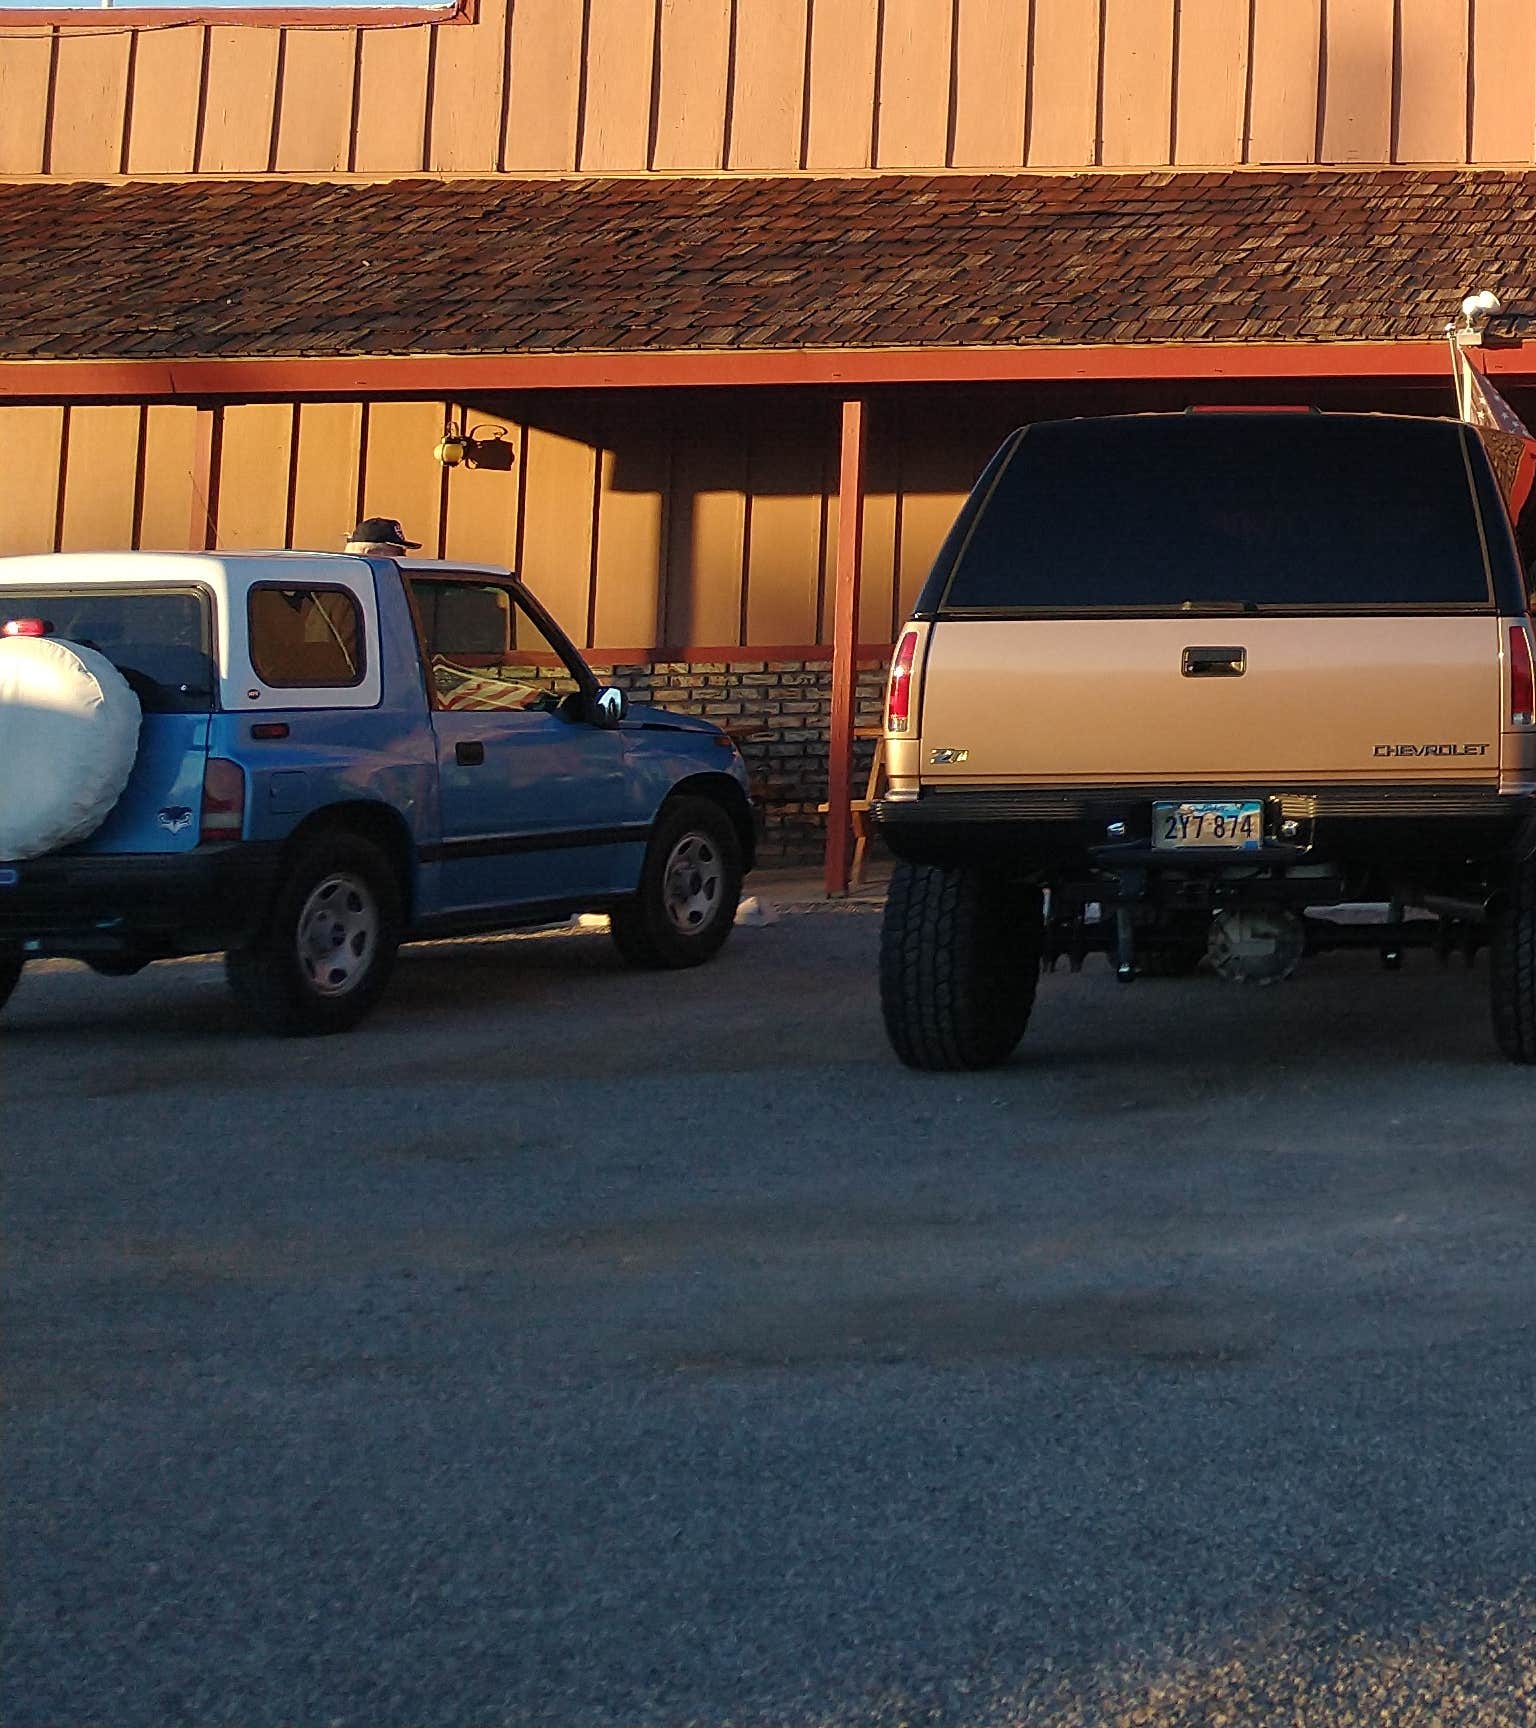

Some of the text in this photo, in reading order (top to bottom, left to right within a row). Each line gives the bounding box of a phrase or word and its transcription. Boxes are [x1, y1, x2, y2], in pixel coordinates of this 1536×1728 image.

[1373, 743, 1490, 757] CHEVROLET
[1164, 815, 1252, 840] 2Y7 874
